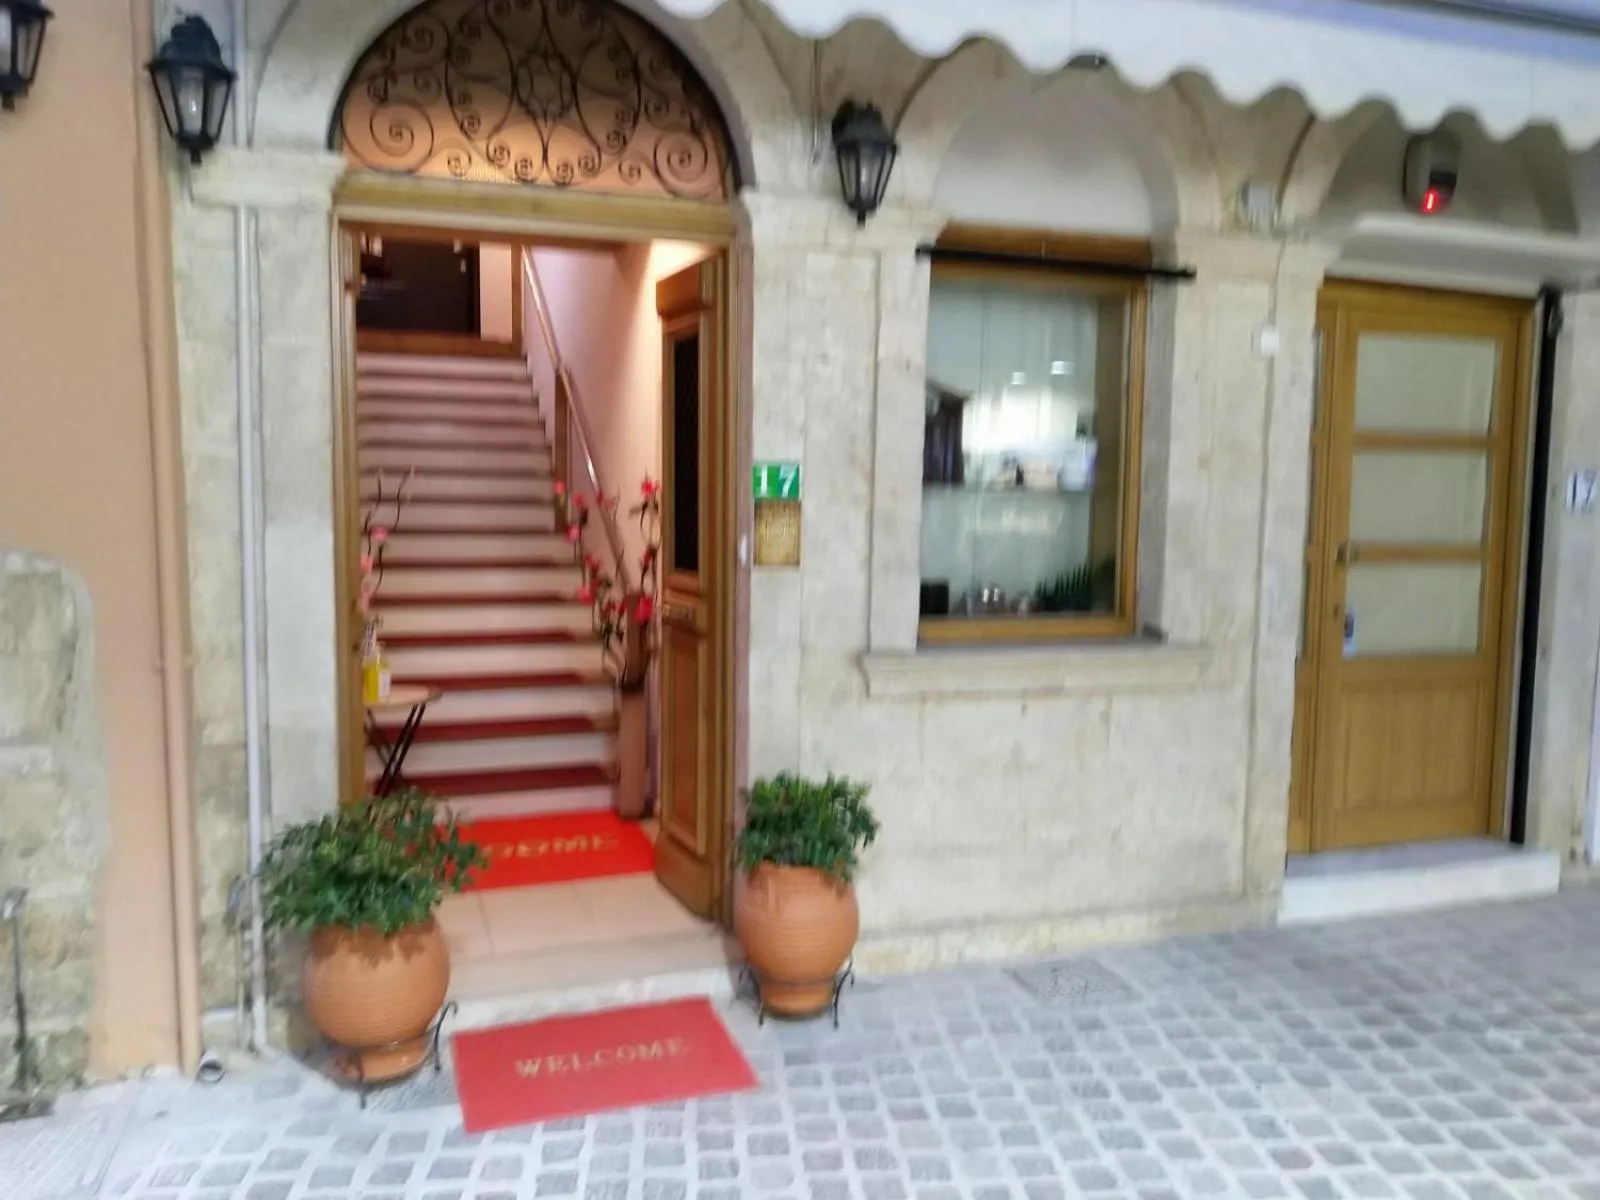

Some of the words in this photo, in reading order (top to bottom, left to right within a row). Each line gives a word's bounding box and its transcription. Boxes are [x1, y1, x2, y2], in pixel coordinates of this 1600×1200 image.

[755, 463, 798, 498] 17
[481, 834, 619, 861] COME
[514, 1036, 689, 1079] WELCOME
